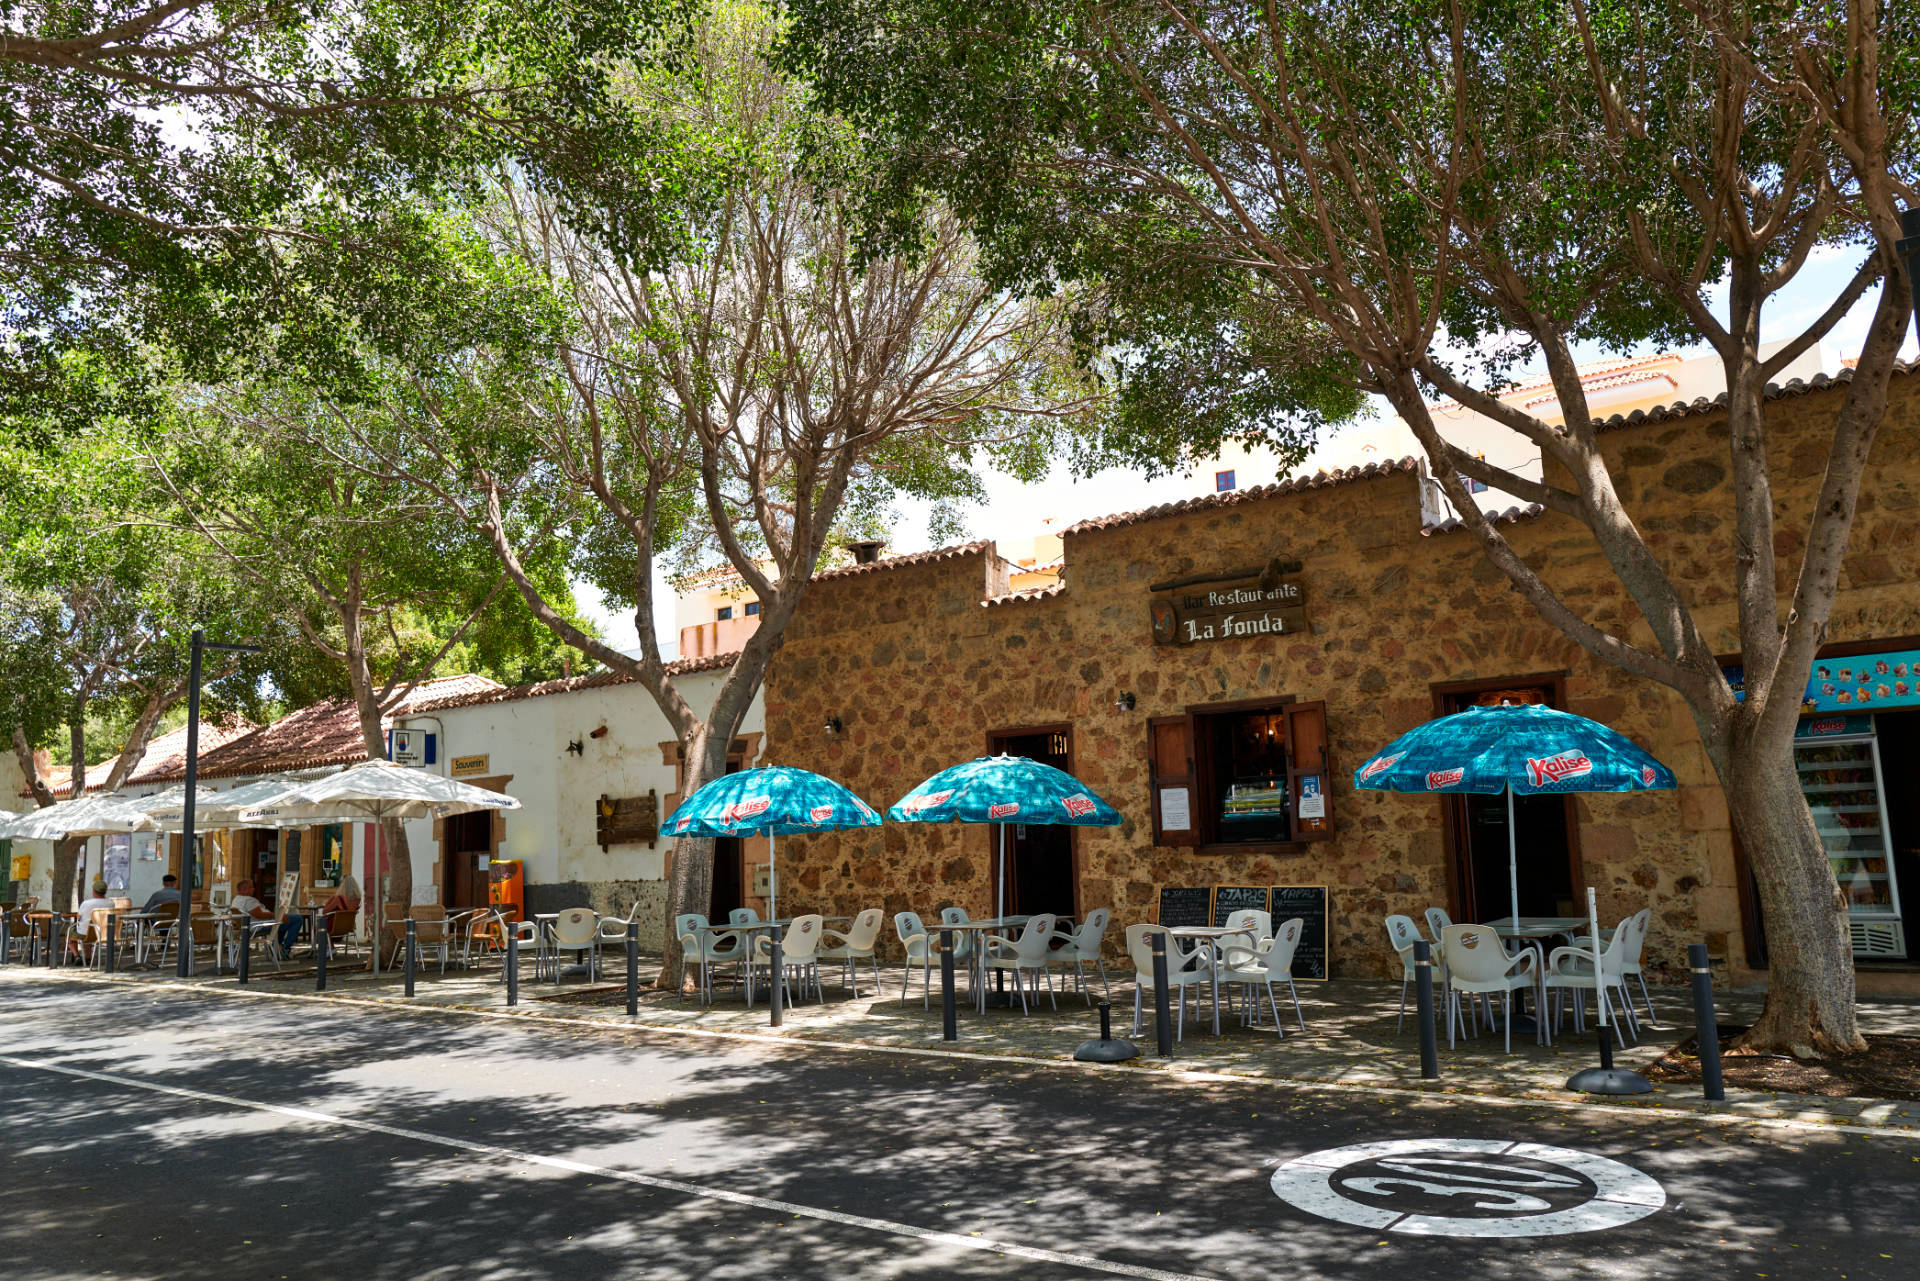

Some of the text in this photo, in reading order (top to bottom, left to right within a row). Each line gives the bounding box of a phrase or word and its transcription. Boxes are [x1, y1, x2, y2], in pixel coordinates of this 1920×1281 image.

[1209, 583, 1298, 607] Restaurante
[1184, 613, 1283, 641] La Fonda
[1812, 720, 1847, 735] Kalise
[455, 759, 484, 770] Souvenirs
[1528, 757, 1593, 787] Kalise
[1428, 770, 1463, 790] Kalise
[720, 800, 770, 824] Kalise
[990, 804, 1019, 820] Kalise
[1061, 797, 1096, 819] Kalise
[1341, 1157, 1583, 1212] 30
